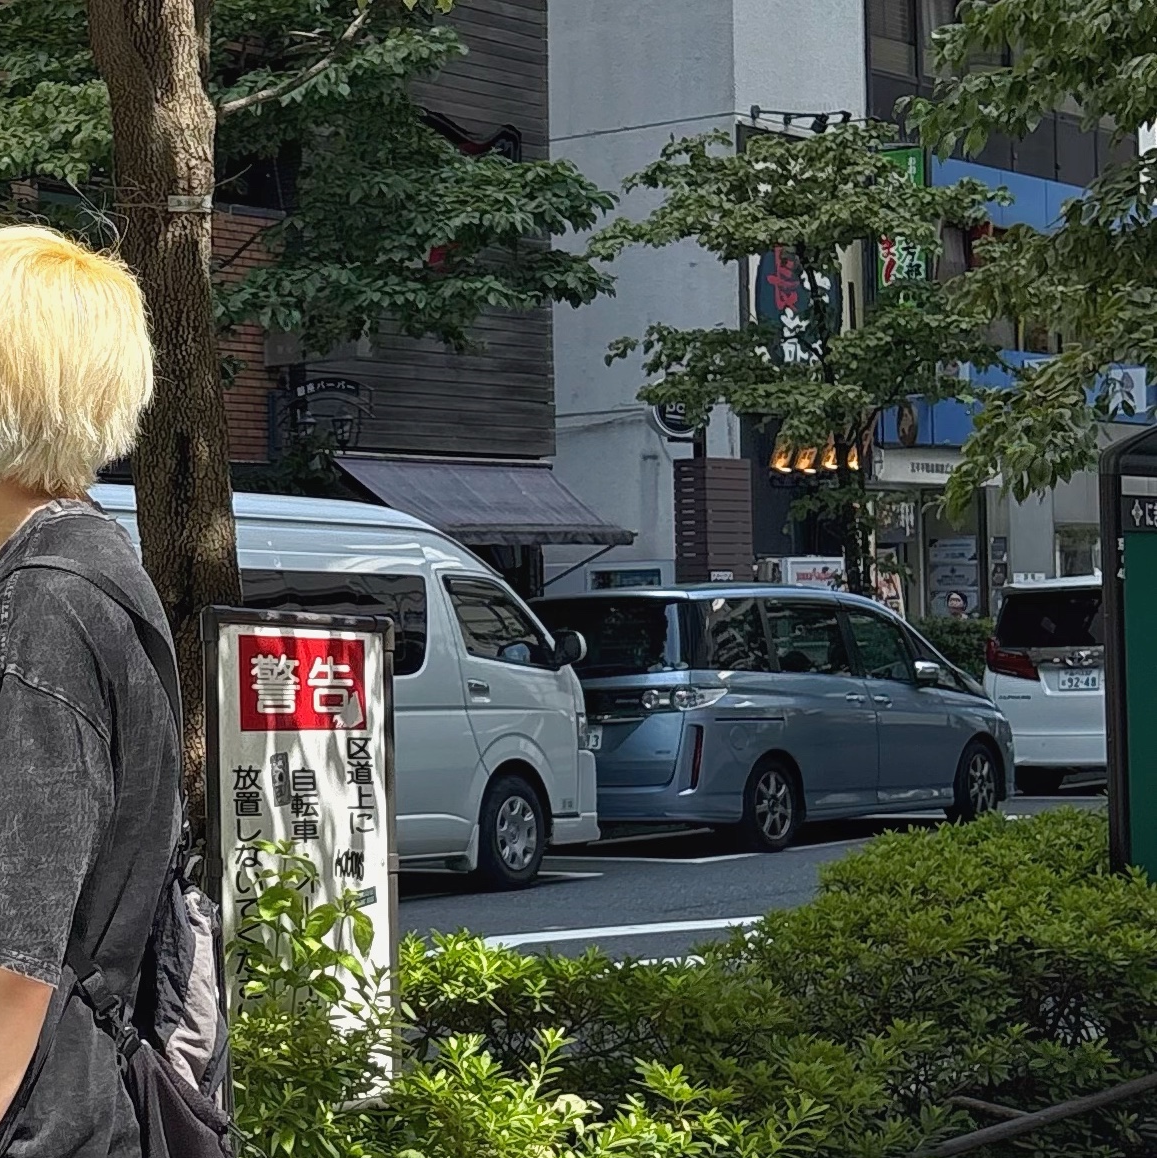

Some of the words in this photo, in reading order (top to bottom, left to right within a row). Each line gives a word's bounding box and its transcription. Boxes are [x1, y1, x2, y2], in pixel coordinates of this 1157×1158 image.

[250, 653, 354, 714] 警告
[346, 736, 375, 835] 区道上に
